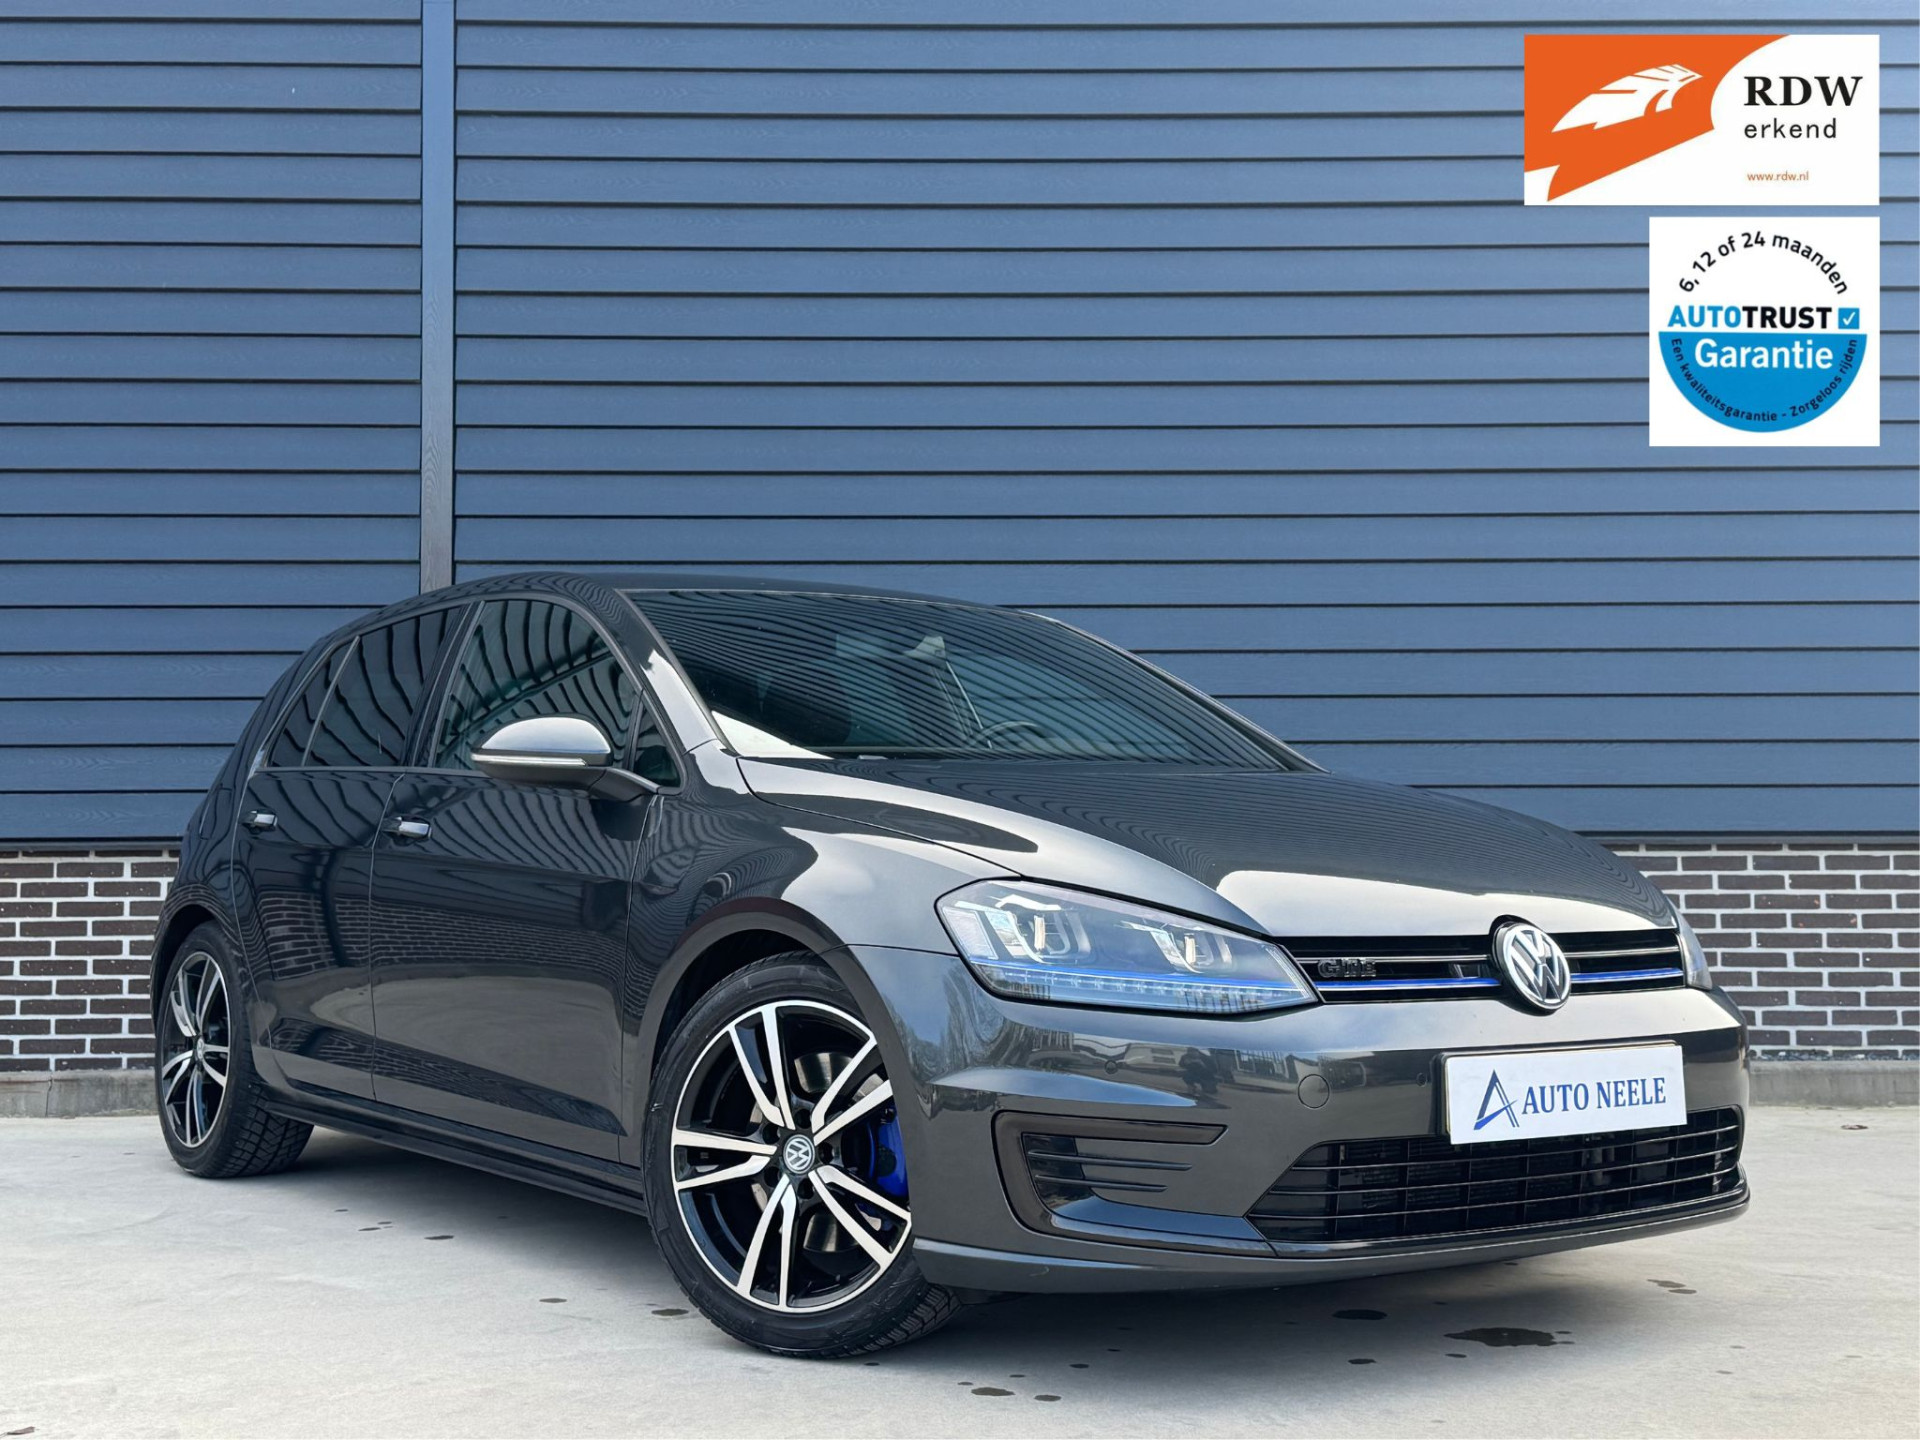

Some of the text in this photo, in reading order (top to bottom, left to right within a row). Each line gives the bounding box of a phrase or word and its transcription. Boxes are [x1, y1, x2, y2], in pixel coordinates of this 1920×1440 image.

[1317, 957, 1377, 978] GTE
[1521, 1077, 1667, 1115] AUTO NEELE
